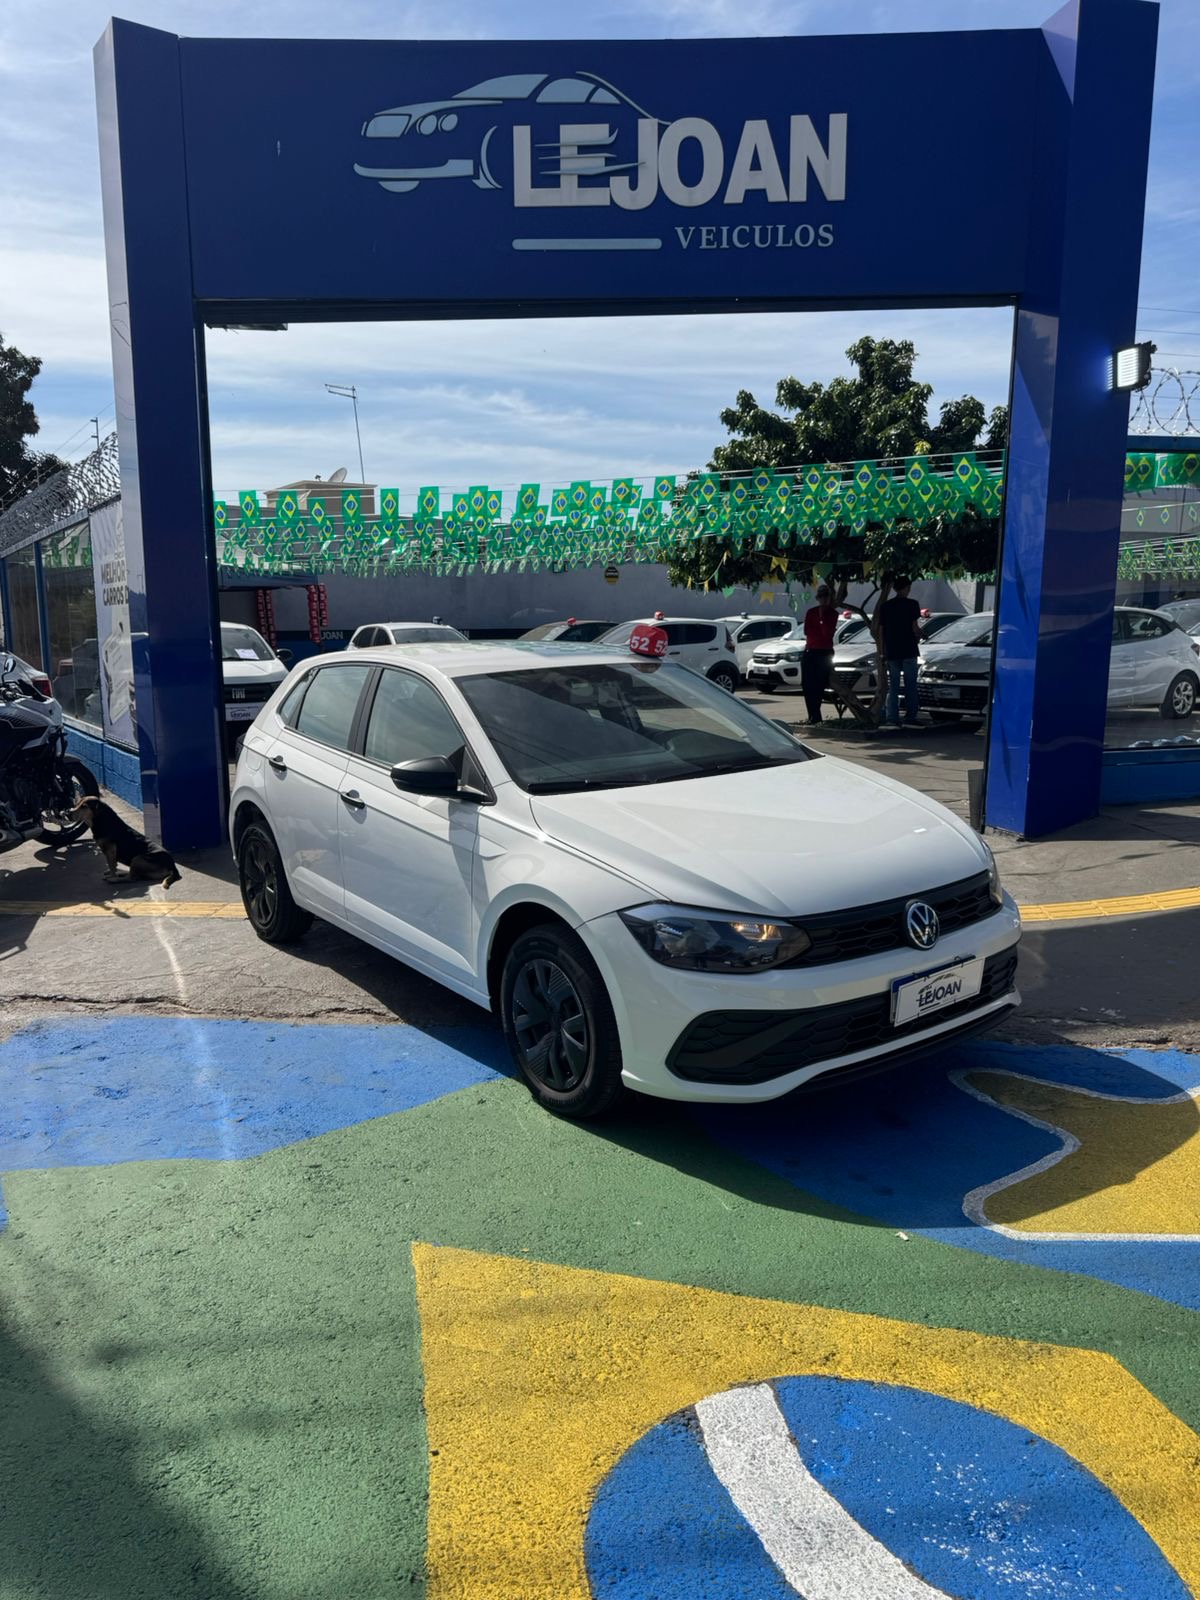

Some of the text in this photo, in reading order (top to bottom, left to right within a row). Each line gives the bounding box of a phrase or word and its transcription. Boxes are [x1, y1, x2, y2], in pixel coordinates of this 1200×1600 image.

[513, 113, 847, 210] LEJOAN
[674, 224, 835, 249] VEICULOS
[630, 635, 650, 652] 52
[918, 980, 962, 1008] LEJOAN
